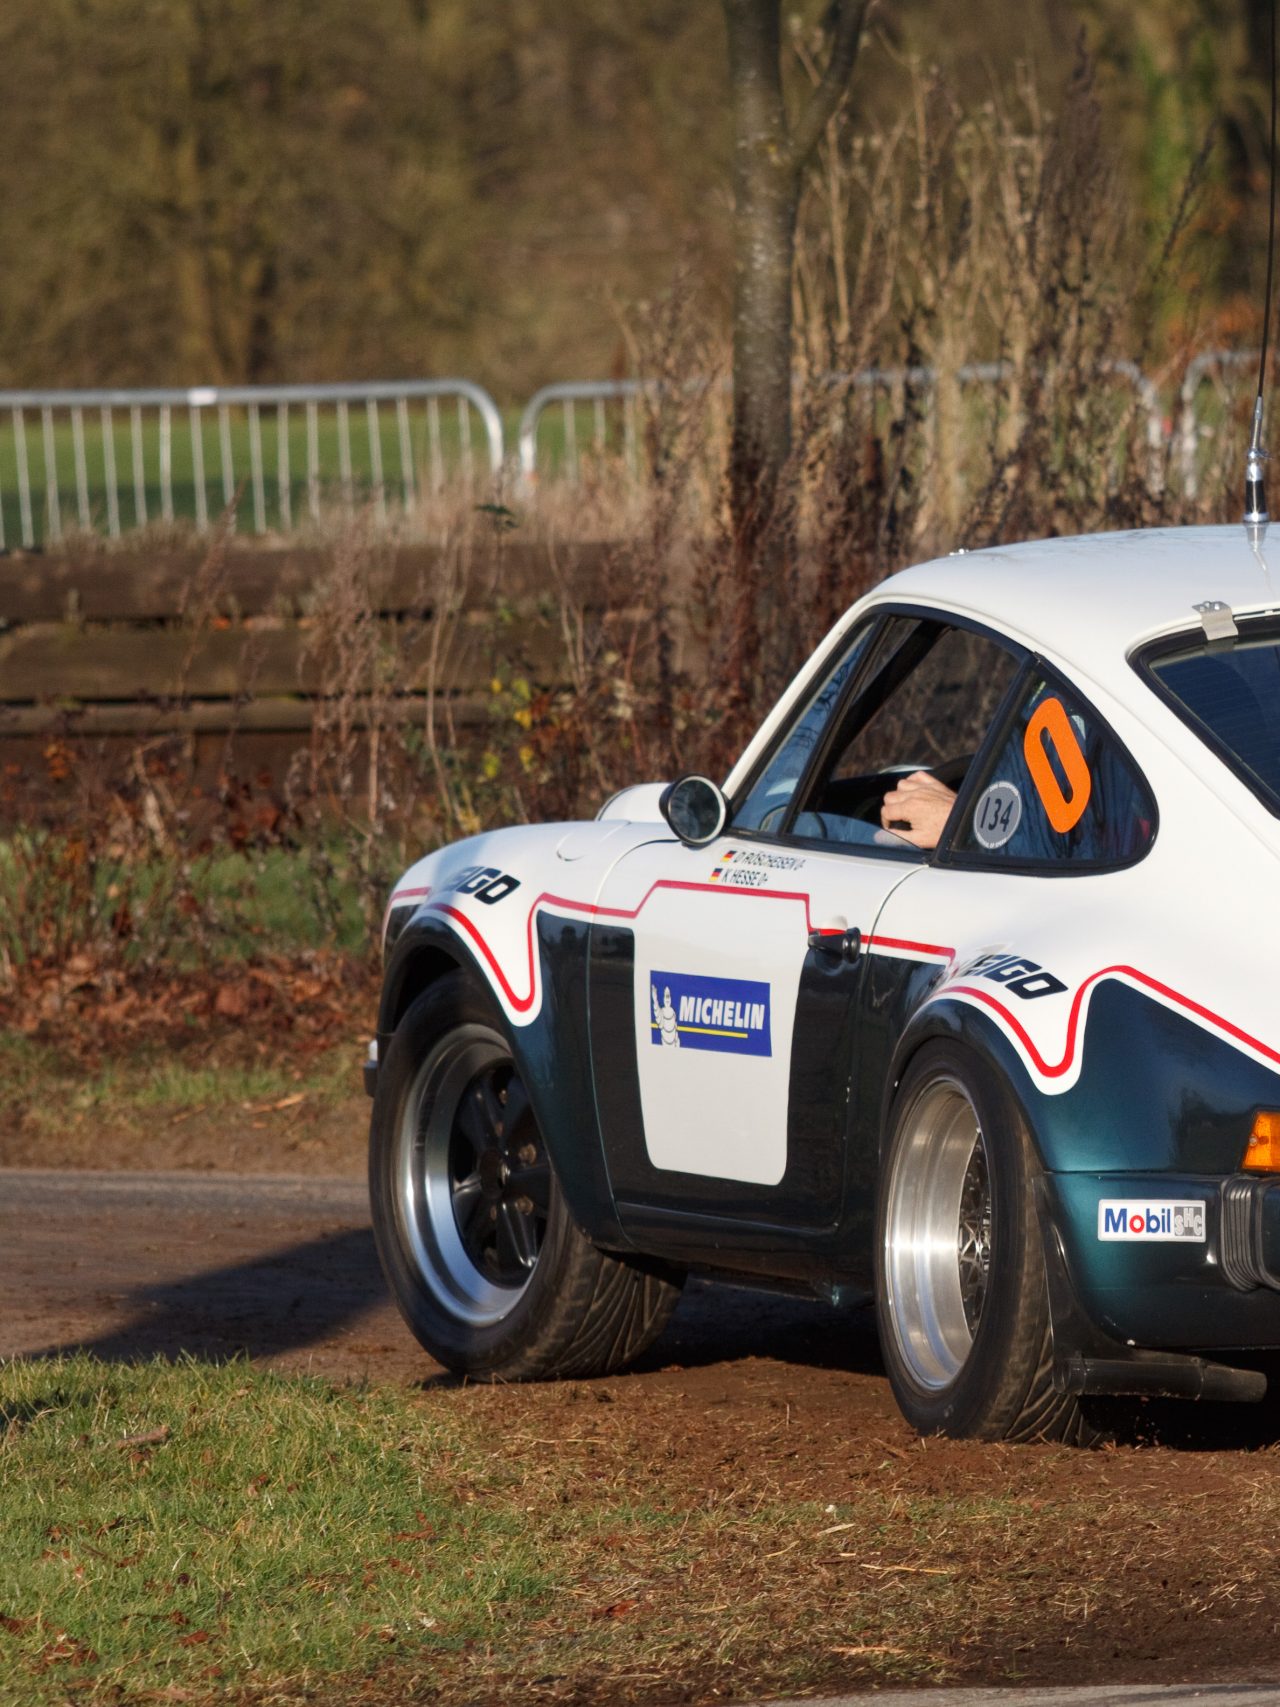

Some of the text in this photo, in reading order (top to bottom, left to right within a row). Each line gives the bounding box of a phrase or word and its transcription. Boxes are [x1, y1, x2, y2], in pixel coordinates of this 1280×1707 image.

[980, 796, 1013, 832] 134
[730, 868, 760, 886] HESSE
[679, 995, 765, 1030] MICHELIN
[1105, 1207, 1203, 1236] Mobil SHC
